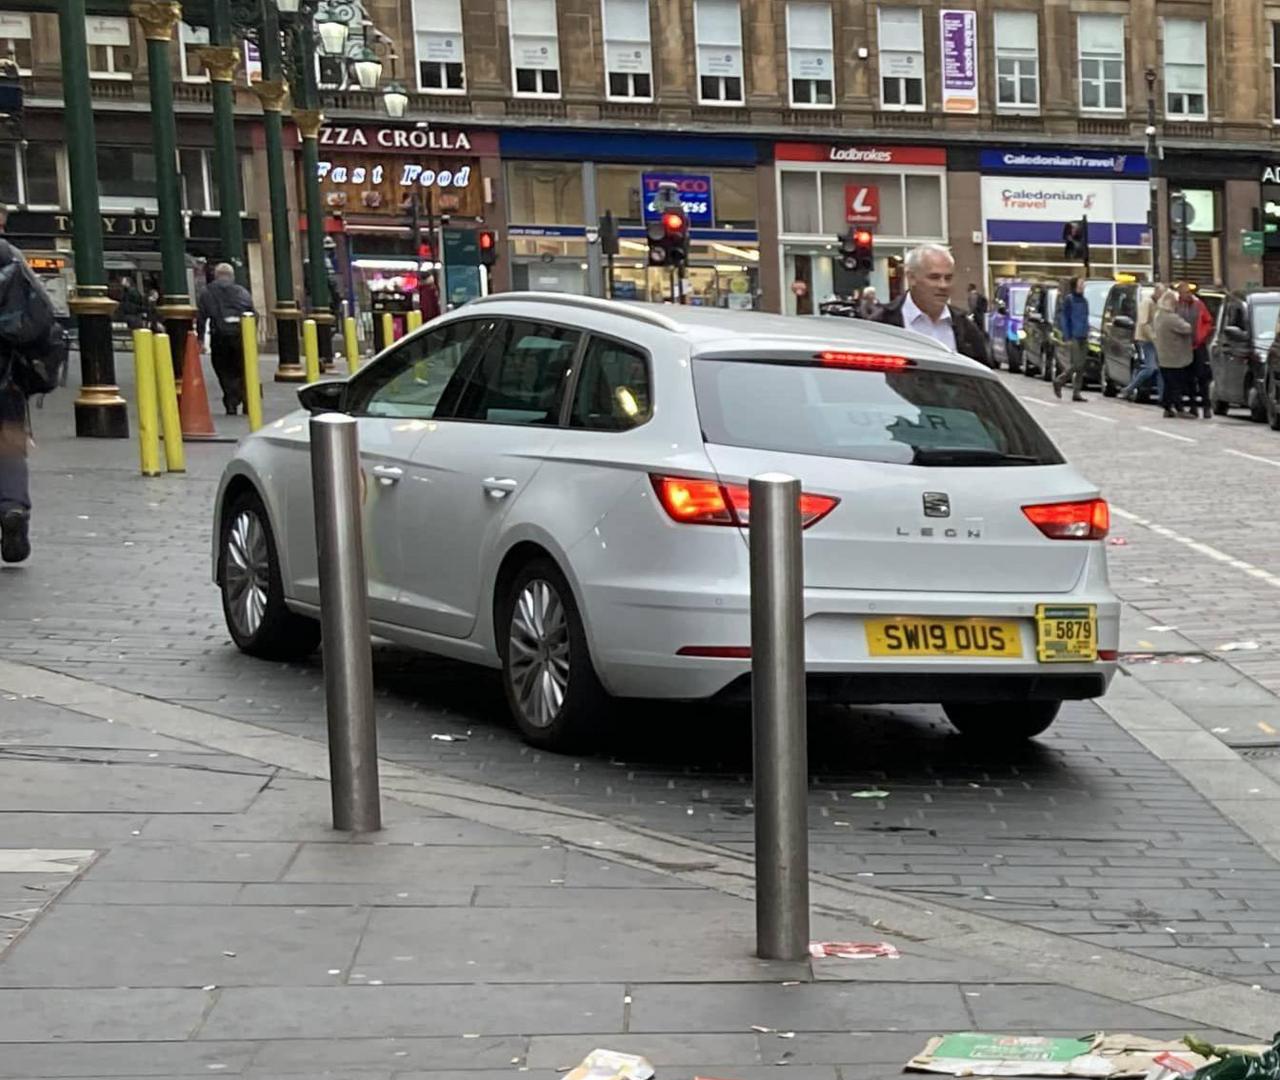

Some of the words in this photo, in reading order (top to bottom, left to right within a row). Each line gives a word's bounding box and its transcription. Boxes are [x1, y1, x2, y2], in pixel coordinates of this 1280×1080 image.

[378, 130, 471, 150] CROLLA
[830, 147, 891, 161] Ladbrokes
[317, 161, 384, 184] Fast
[400, 164, 470, 187] Food
[646, 177, 707, 192] TSCO
[1001, 188, 1083, 201] Caledonian
[1002, 198, 1047, 209] Travel
[54, 214, 116, 232] TY
[129, 215, 158, 233] JU
[885, 624, 946, 652] SW19
[1056, 621, 1092, 640] 5879
